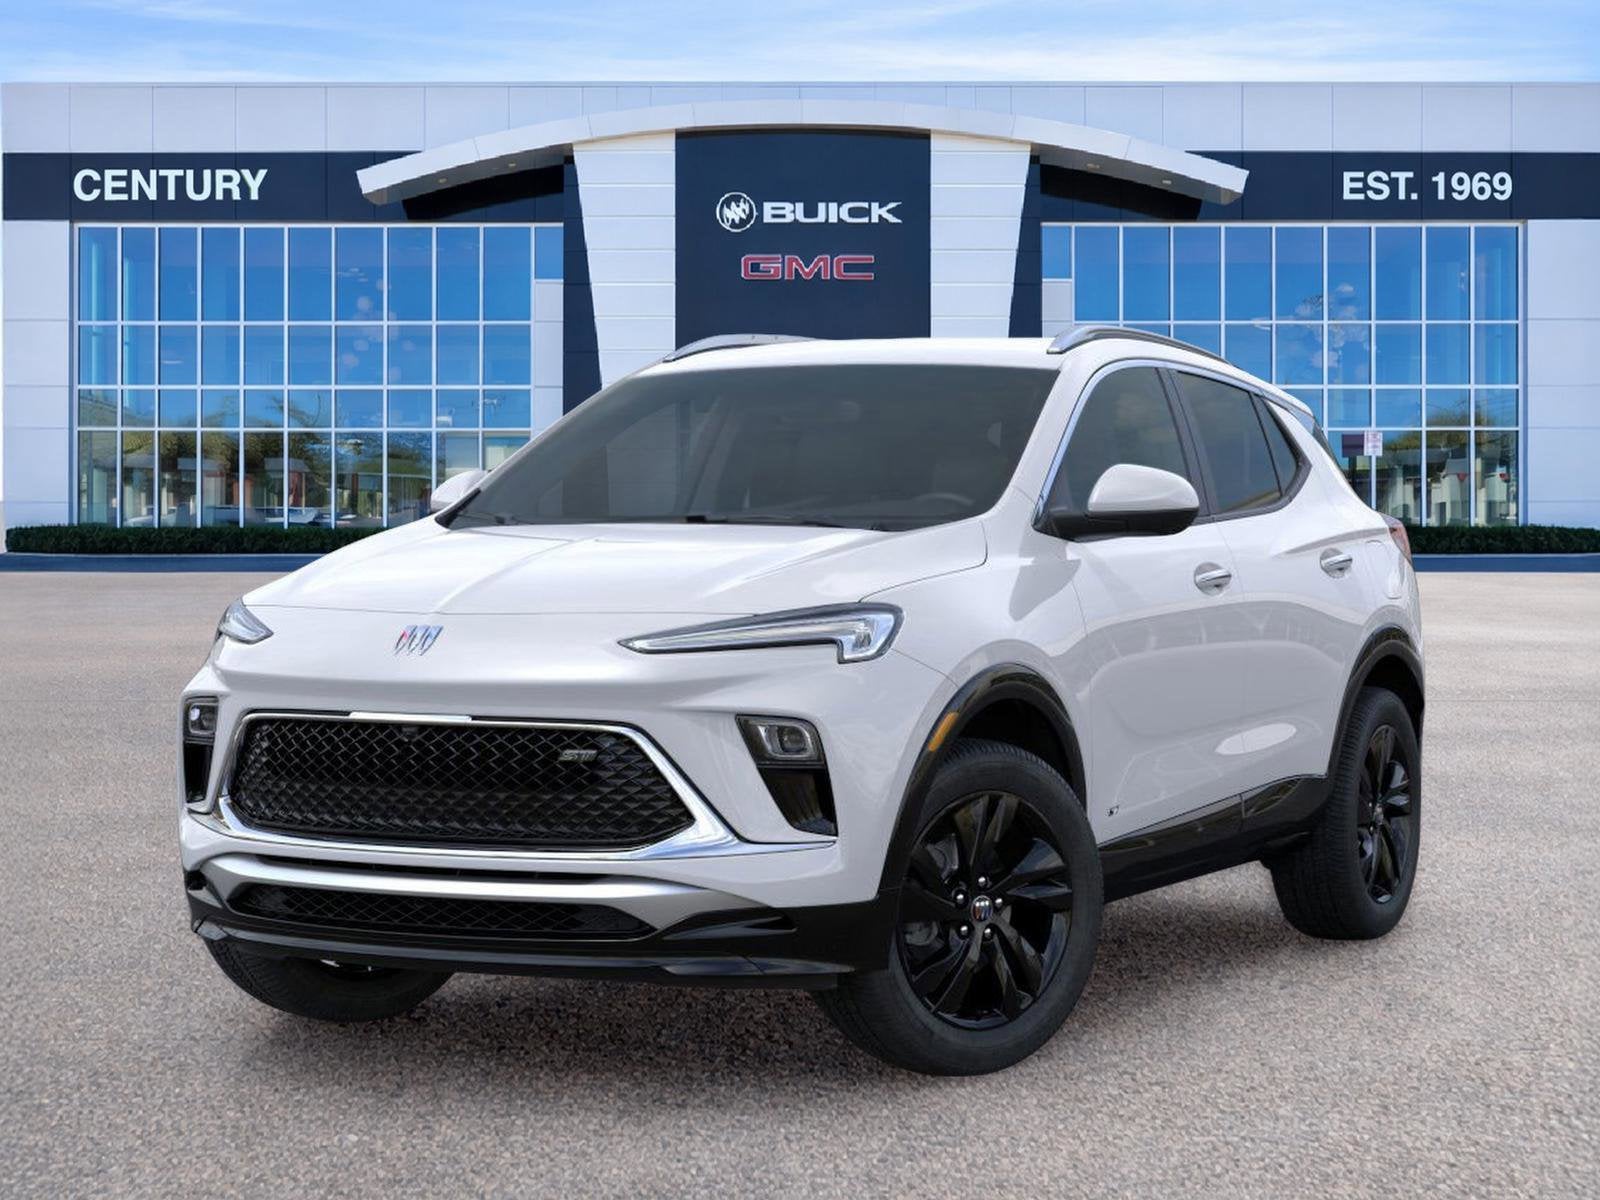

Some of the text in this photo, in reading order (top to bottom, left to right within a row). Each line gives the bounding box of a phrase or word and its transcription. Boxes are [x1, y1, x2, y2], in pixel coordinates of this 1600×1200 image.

[73, 168, 268, 201] CENTURY
[1342, 170, 1513, 201] EST. 1969
[762, 201, 902, 224] BUICK
[741, 254, 875, 280] GMC
